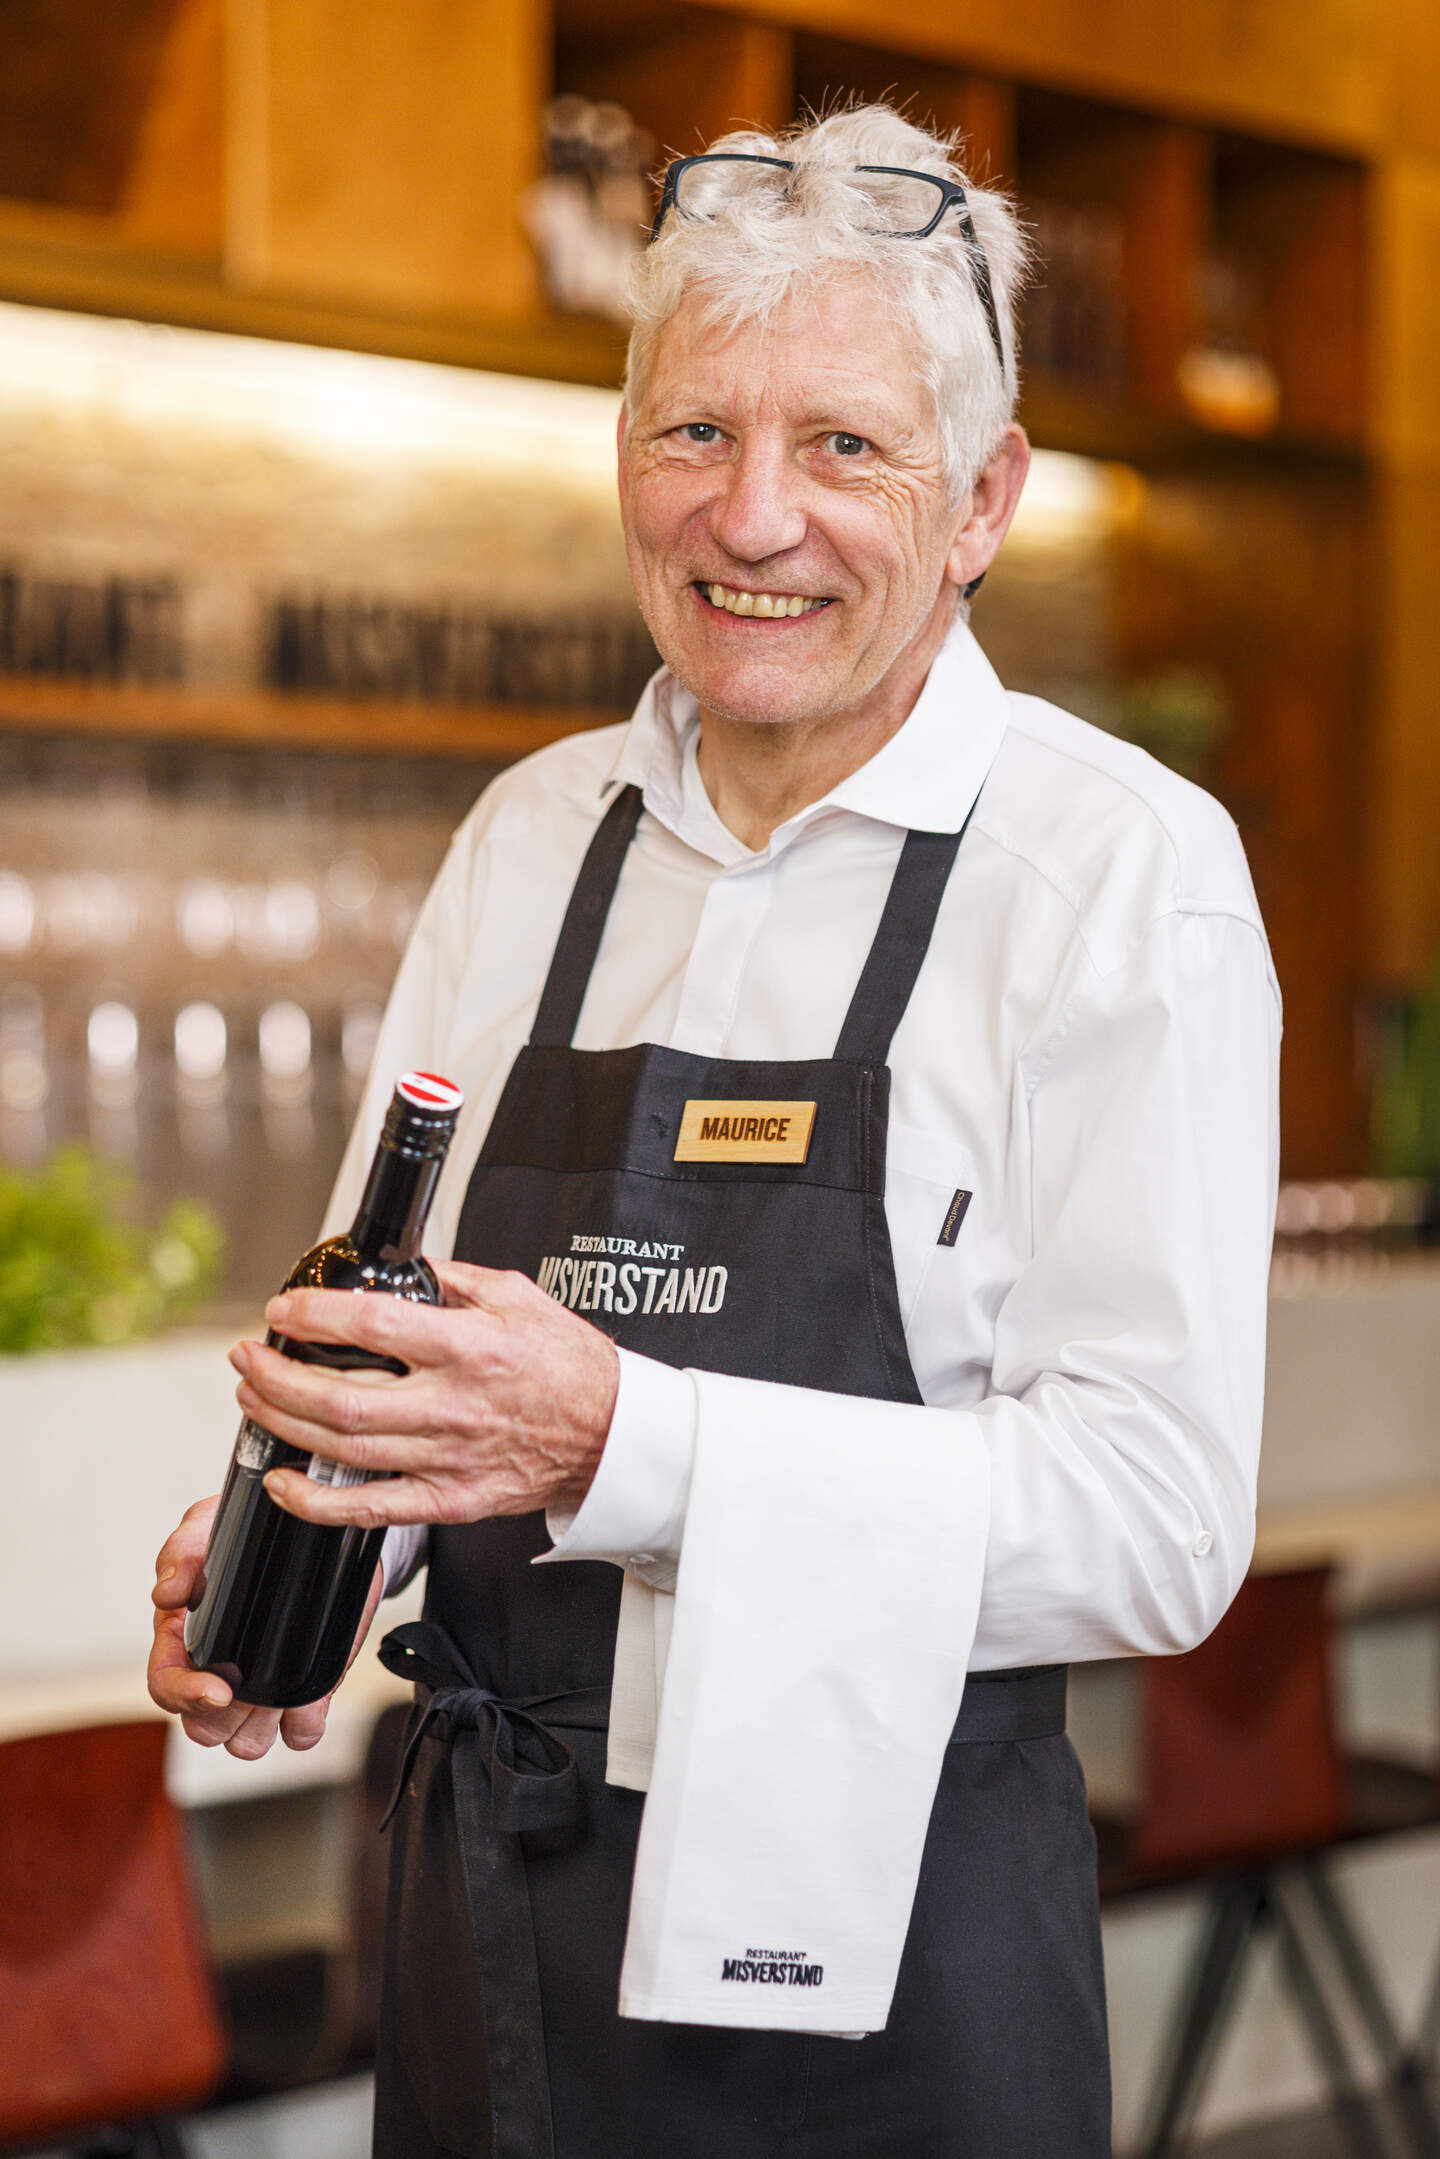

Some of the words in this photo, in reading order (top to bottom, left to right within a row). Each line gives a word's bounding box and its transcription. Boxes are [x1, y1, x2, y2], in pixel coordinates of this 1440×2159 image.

[700, 1117, 791, 1142] MAURICE
[570, 1235, 684, 1261] RESTAURANT
[746, 1948, 807, 1961] RESTAURANT
[721, 1959, 824, 1987] MISVERSTAND
